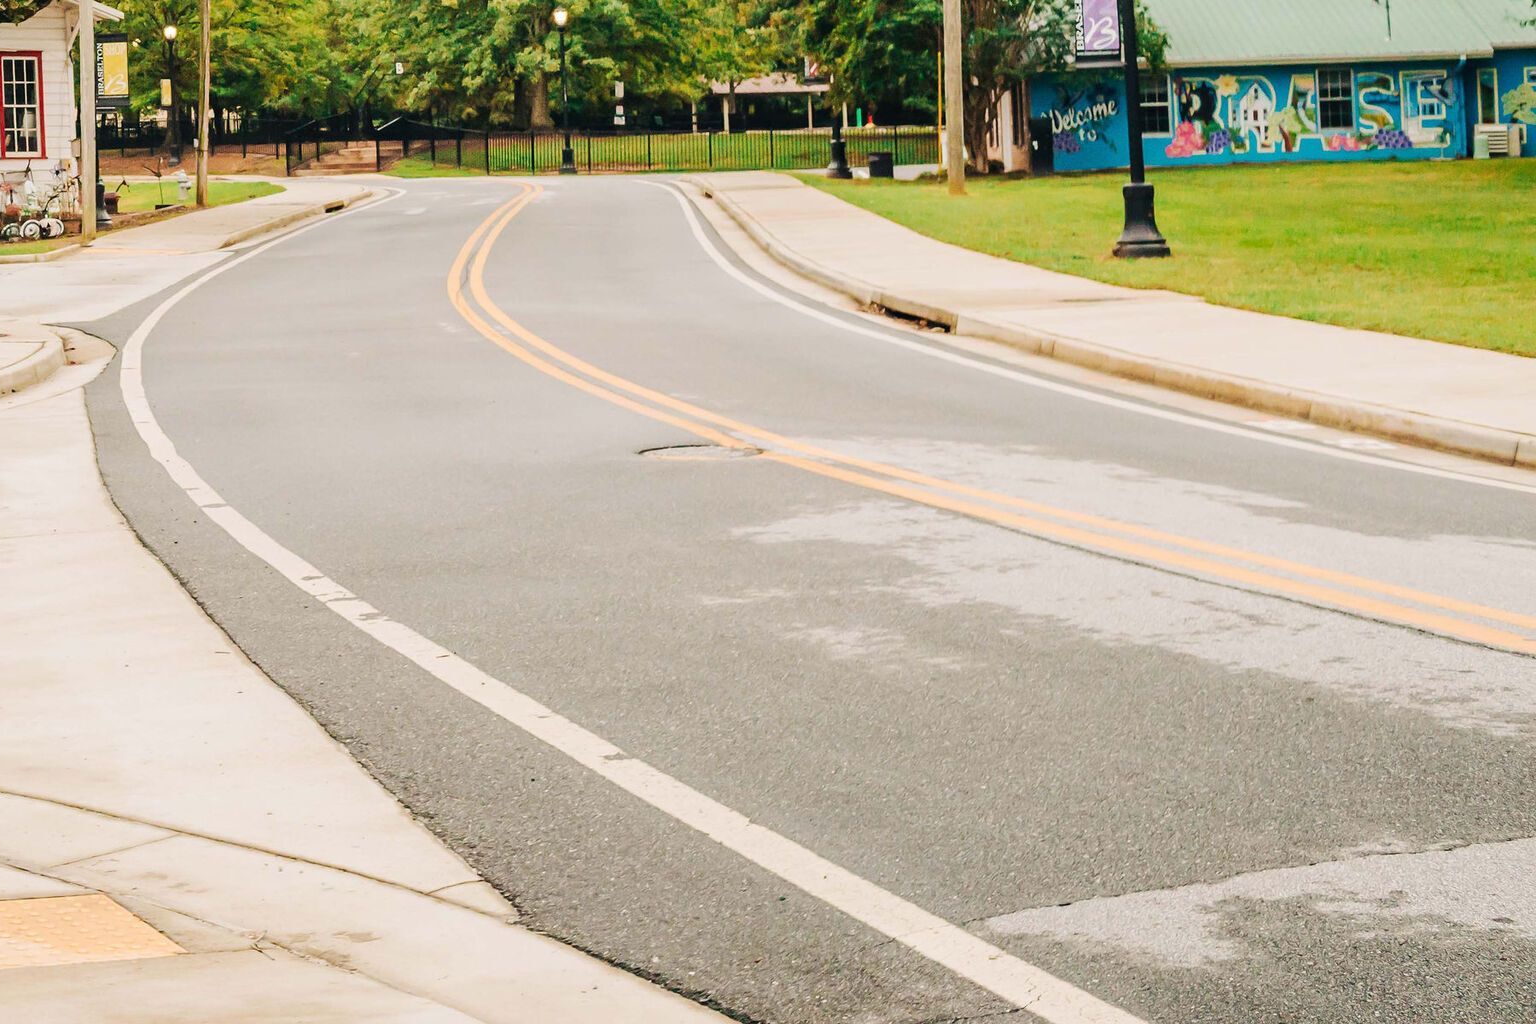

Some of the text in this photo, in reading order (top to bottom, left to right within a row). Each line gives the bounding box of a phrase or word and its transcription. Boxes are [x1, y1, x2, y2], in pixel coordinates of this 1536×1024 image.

[96, 42, 104, 95] BRASELTON
[1041, 99, 1120, 135] Welcome
[1079, 127, 1098, 142] to
